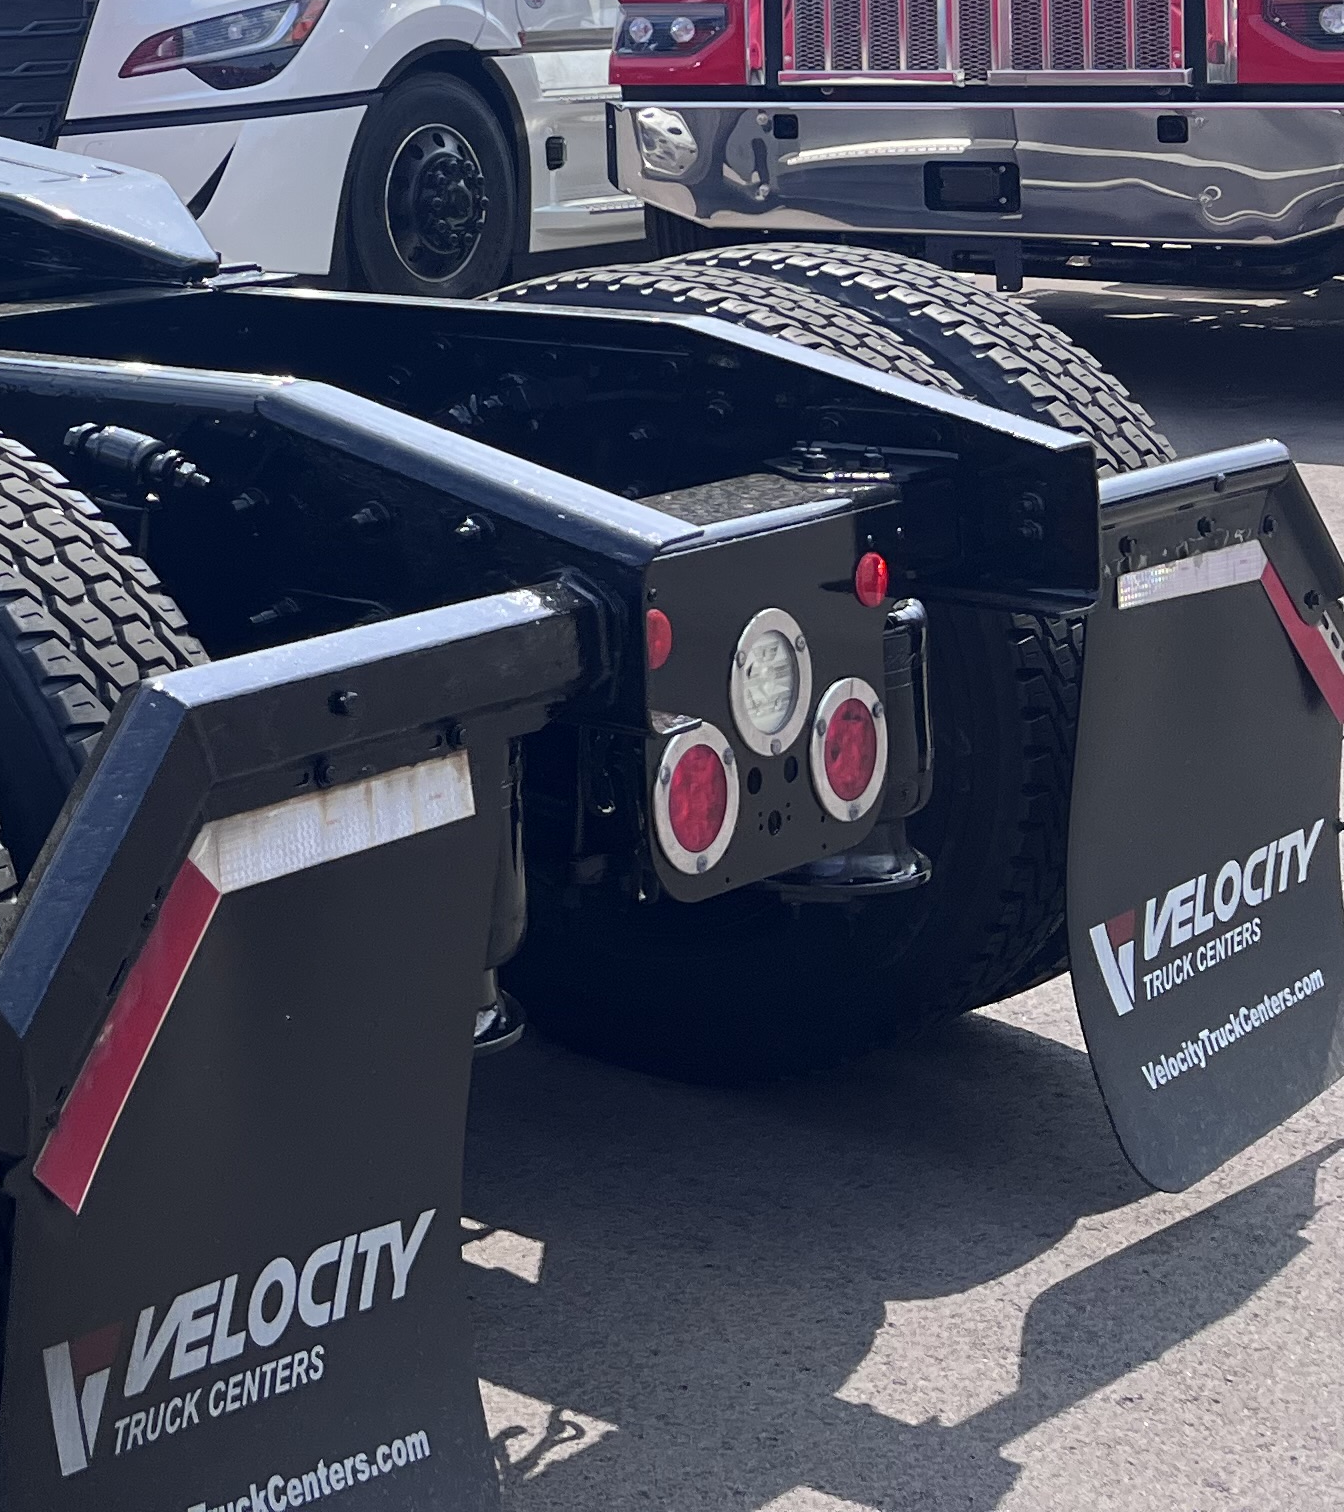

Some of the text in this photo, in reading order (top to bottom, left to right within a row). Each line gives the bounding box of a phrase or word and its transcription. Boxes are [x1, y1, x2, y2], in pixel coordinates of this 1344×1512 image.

[1144, 818, 1325, 961] VELOCITY
[1143, 917, 1262, 1002] TRUCK CENTERS
[1141, 967, 1325, 1091] VelocityTruckCenters.com
[123, 1208, 437, 1397] VELOCITY
[114, 1344, 325, 1456] TRUCK CENTERS
